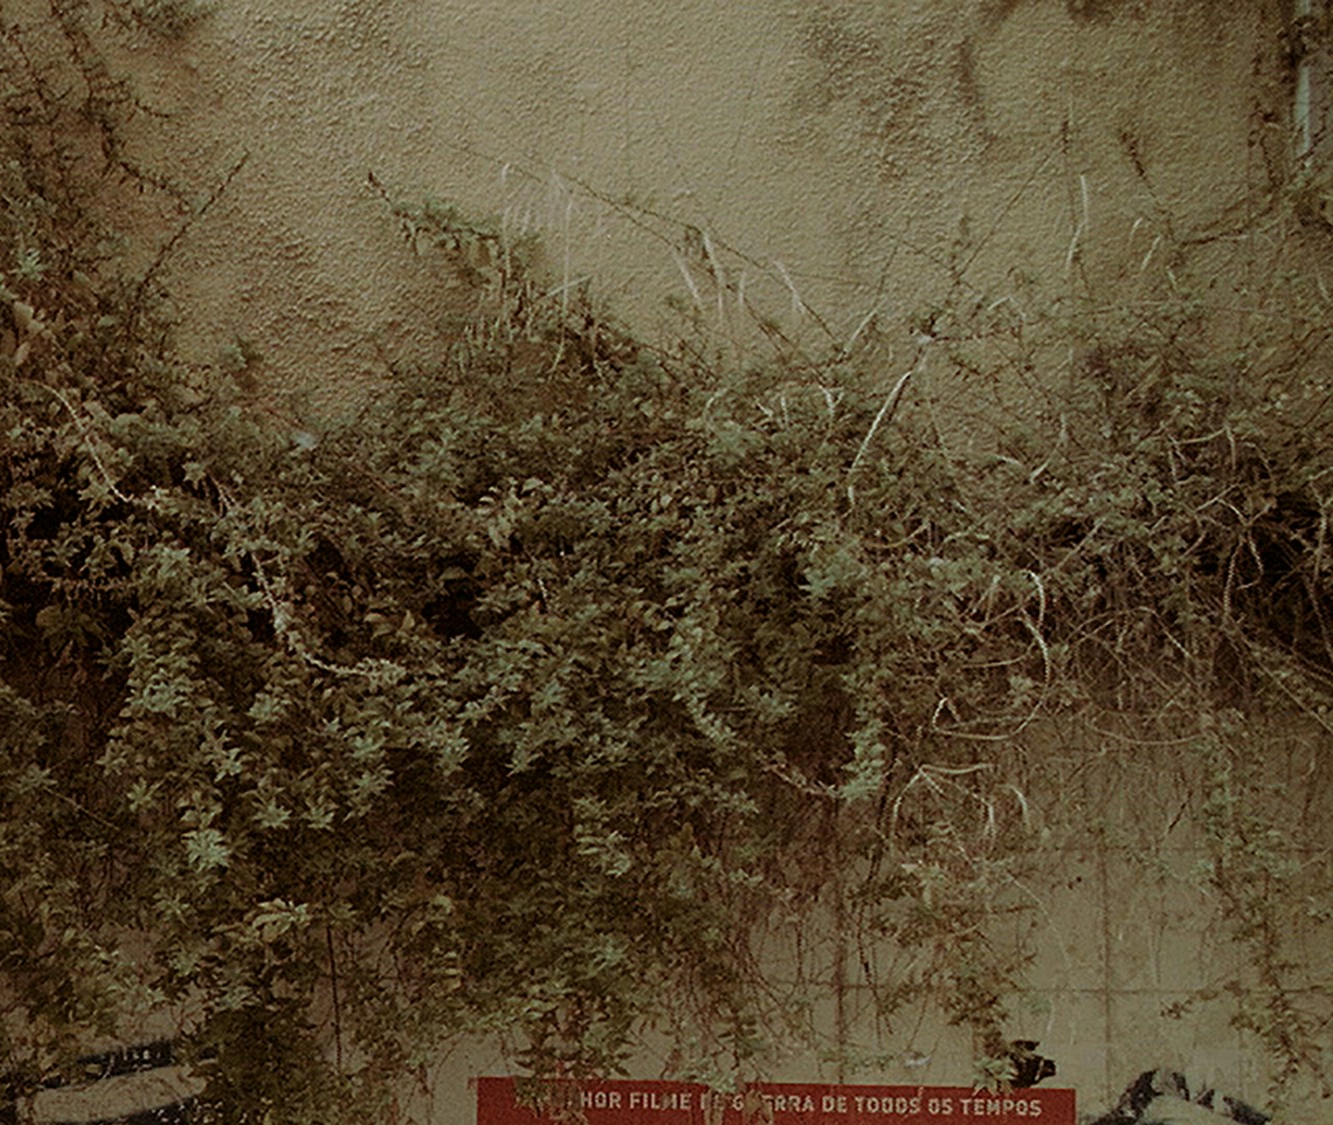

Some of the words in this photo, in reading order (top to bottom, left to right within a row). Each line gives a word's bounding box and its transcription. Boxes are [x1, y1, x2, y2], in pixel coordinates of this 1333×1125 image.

[731, 1093, 815, 1113] GRRA
[821, 1096, 848, 1114] DE
[854, 1095, 921, 1115] TODOS
[927, 1097, 954, 1115] OS
[960, 1098, 1043, 1118] TEMPOS
